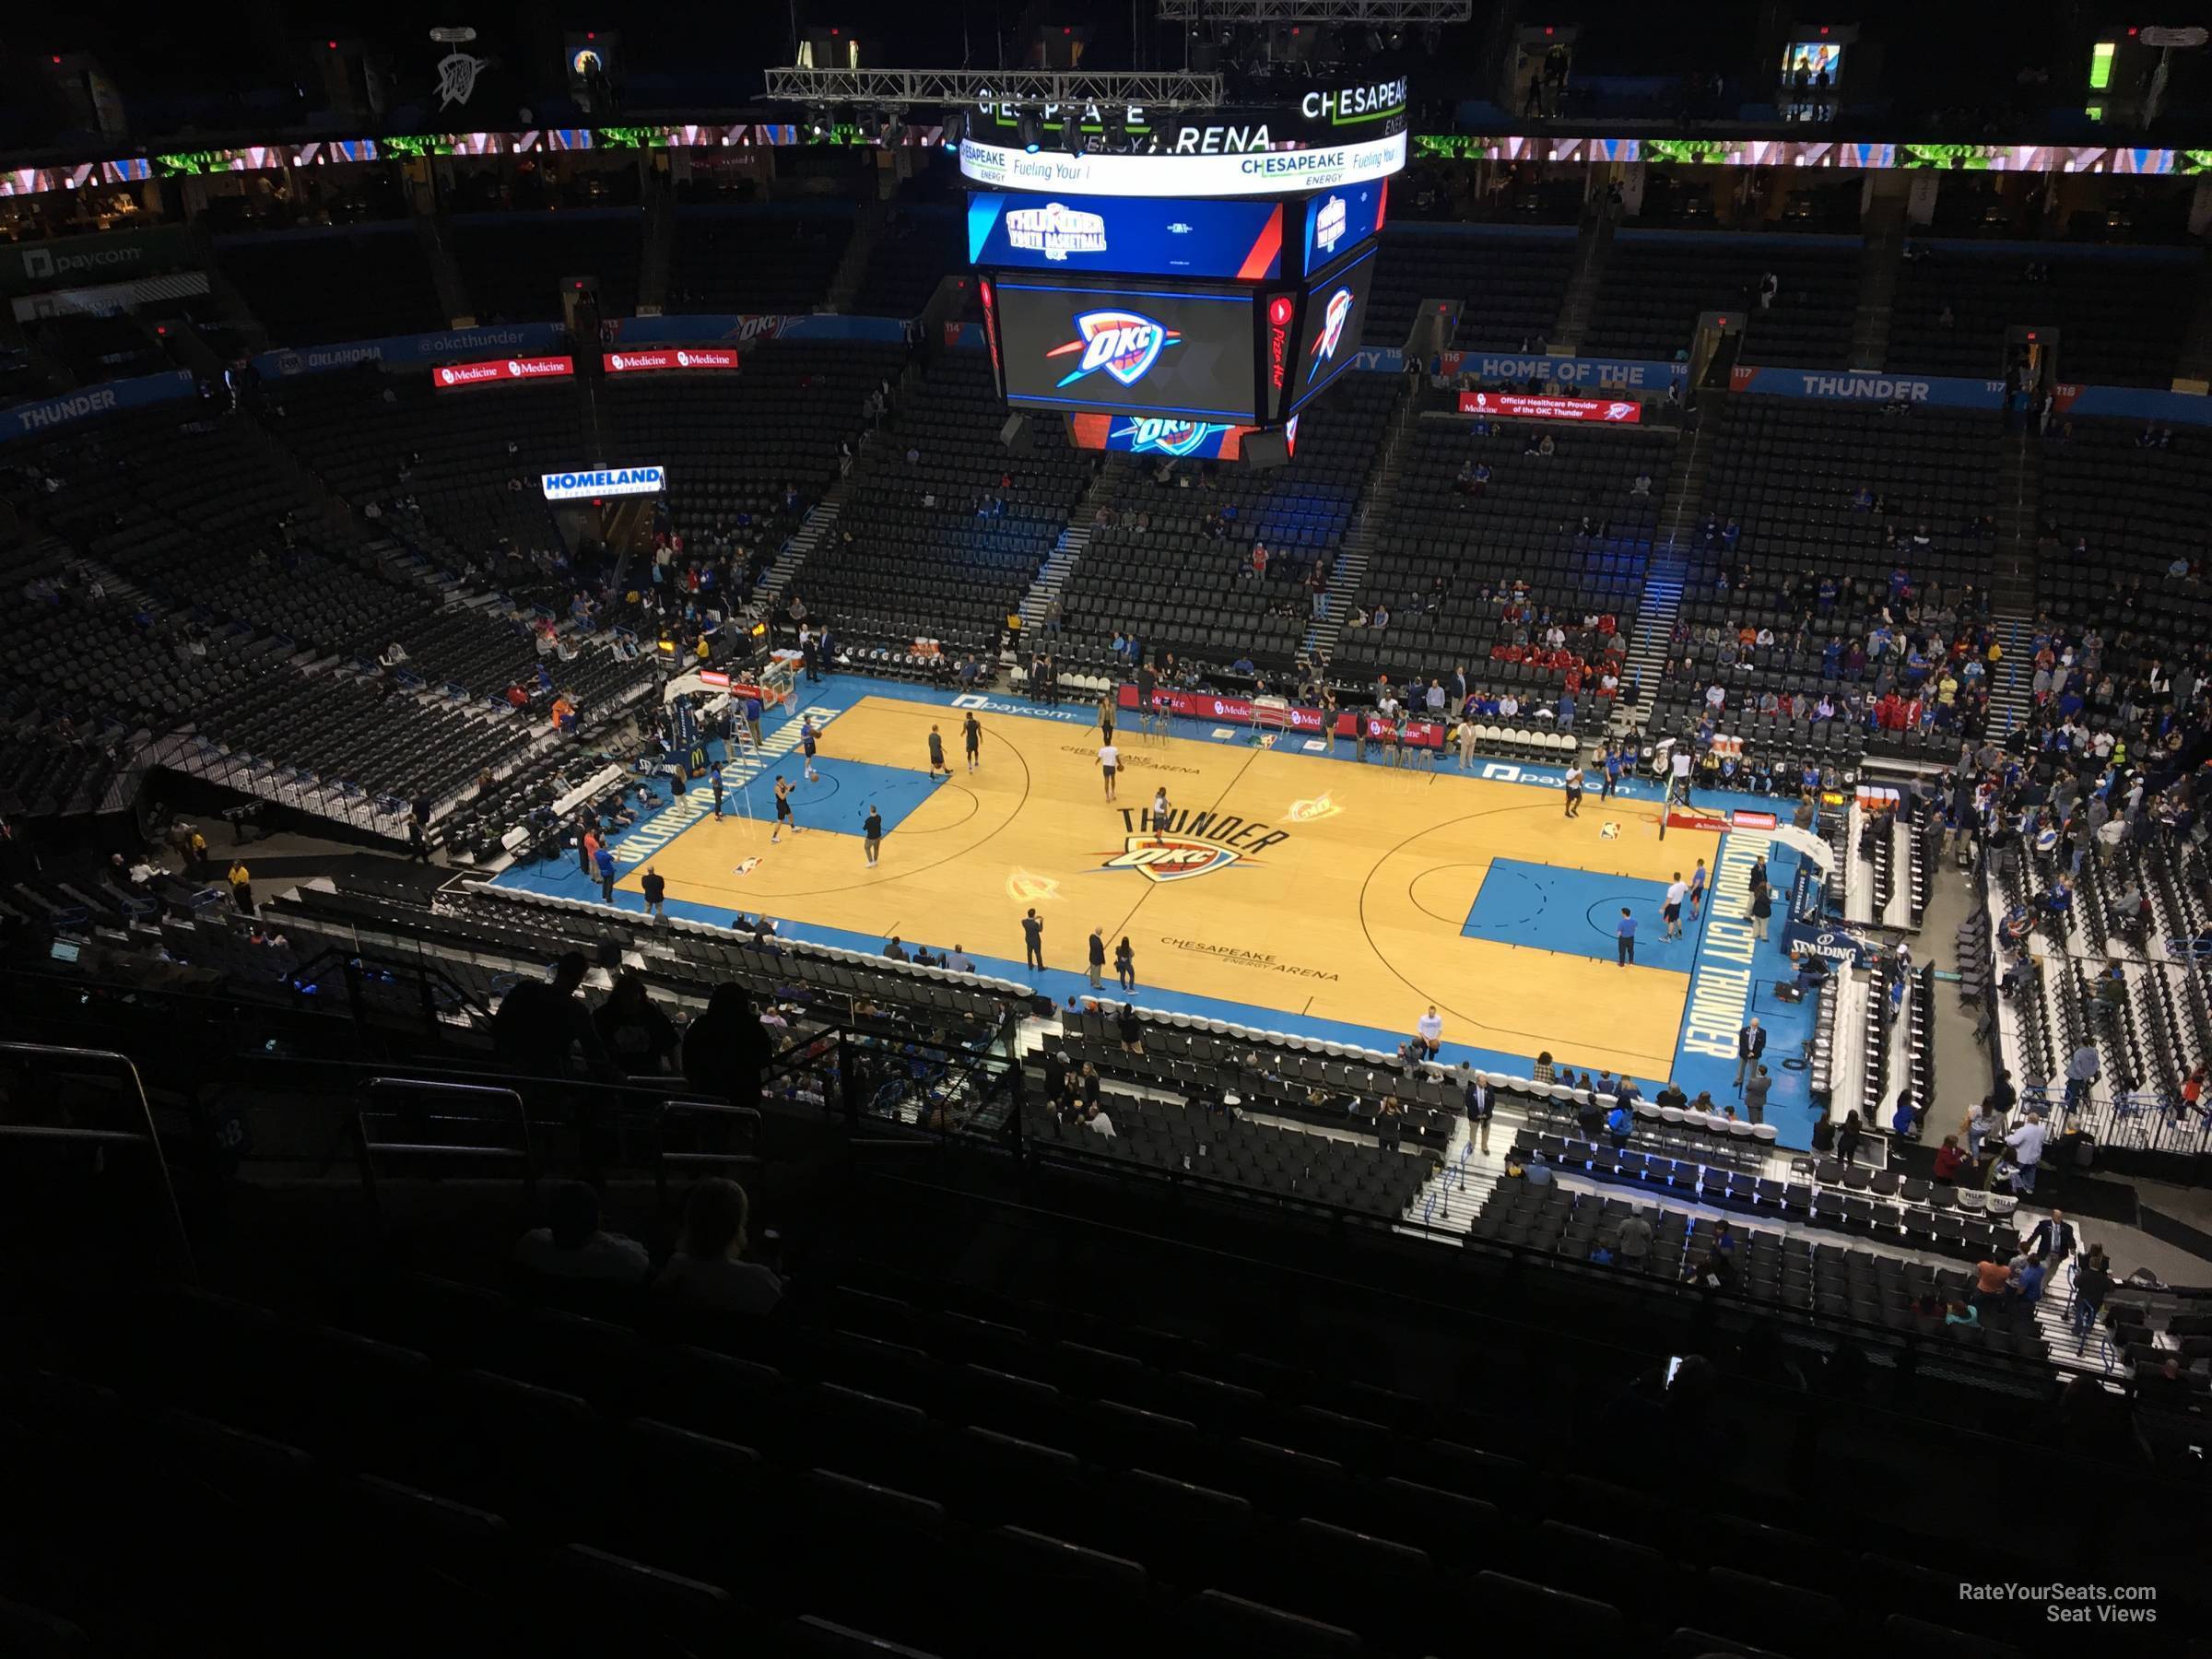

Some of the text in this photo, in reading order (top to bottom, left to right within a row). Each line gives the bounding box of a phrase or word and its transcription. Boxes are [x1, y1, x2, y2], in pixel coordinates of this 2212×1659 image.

[1149, 124, 1269, 154] RENA
[1014, 159, 1052, 180] Fueling
[1056, 164, 1081, 179] Your
[1241, 152, 1345, 174] CHESAPEAKE
[981, 170, 1005, 182] ENERGY
[1306, 173, 1343, 185] ENERGY
[56, 246, 142, 272] paycom
[419, 330, 524, 354] @okcthunder
[1083, 325, 1151, 370] OKC
[309, 347, 382, 366] OKLAHOMA
[689, 354, 730, 365] Medicine
[1386, 348, 1402, 359] 115
[1443, 352, 1460, 362] 116
[522, 362, 564, 373] Medicine
[624, 356, 666, 367] Medicine
[455, 367, 497, 381] Medicine
[1483, 359, 1645, 384] HOME OF THE
[1670, 364, 1688, 375] 116
[1734, 368, 1753, 378] 117
[1273, 364, 1285, 390] Hut
[1803, 376, 1929, 401] THUNDER
[1985, 382, 2006, 393] 117
[18, 388, 117, 430] THUNDER
[1465, 404, 1498, 414] Medicine
[1500, 396, 1598, 410] Official Healthcare Provider
[1535, 407, 1552, 416] OKC
[1554, 408, 1584, 418] Thunder
[547, 468, 660, 490] HOMELAND
[846, 647, 853, 655] G
[858, 648, 865, 656] G
[893, 653, 900, 662] G
[906, 655, 912, 664] G
[918, 656, 924, 665] G
[954, 662, 960, 670] G
[981, 701, 1074, 719] paycom
[1642, 747, 1652, 757] G
[1061, 745, 1152, 764] CHESAKE
[1150, 763, 1200, 775] ARENA
[1775, 763, 1784, 772] G
[1520, 772, 1630, 794] payom
[1844, 772, 1853, 782] G
[1116, 807, 1290, 854] THUNDER
[1108, 847, 1215, 865] OKC
[1160, 936, 1277, 962] CHESAPEAKE
[1703, 921, 1756, 965] CITY
[1222, 958, 1339, 982] ENERGY ARENA
[1683, 965, 1751, 1061] THUNDER
